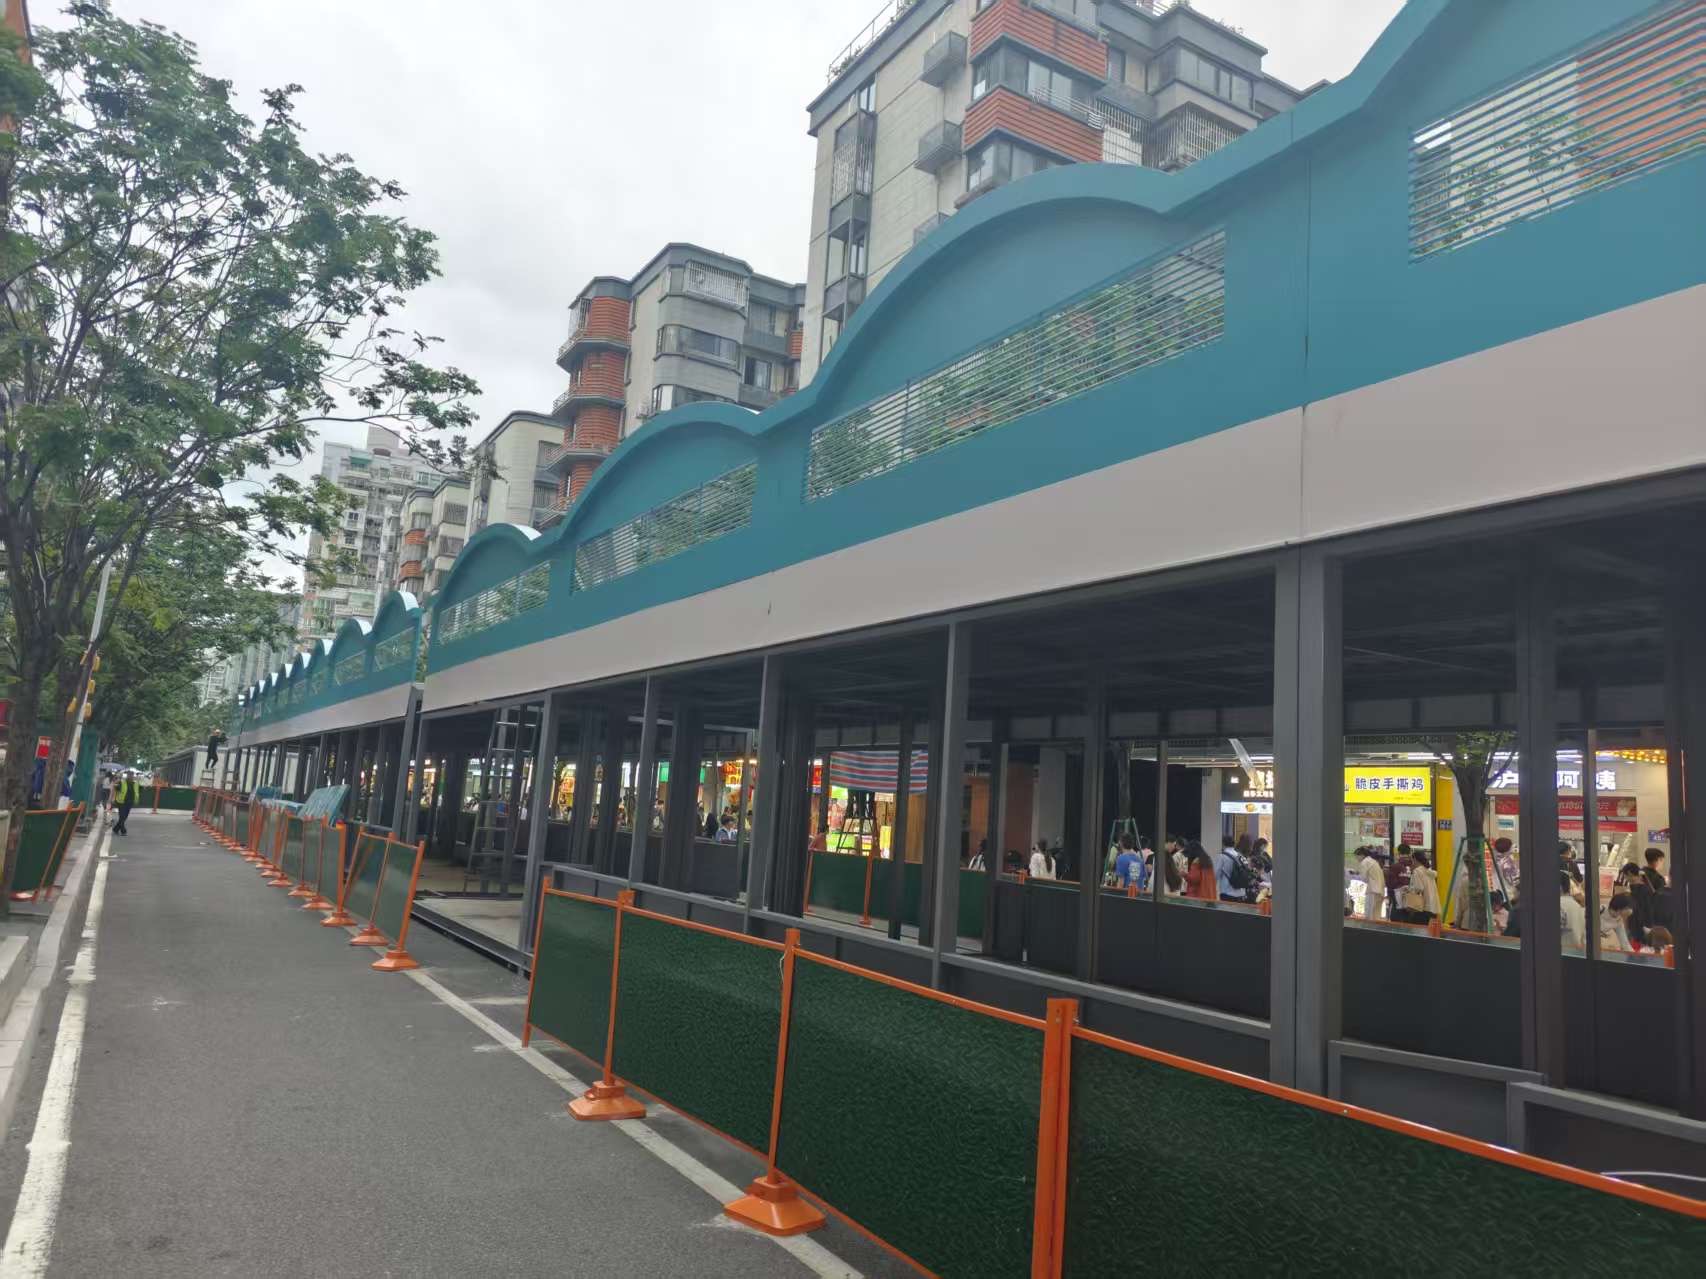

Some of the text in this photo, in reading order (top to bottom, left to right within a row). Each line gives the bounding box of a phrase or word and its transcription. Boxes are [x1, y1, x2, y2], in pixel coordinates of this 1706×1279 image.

[1355, 777, 1425, 791] 脆皮手撕鸡
